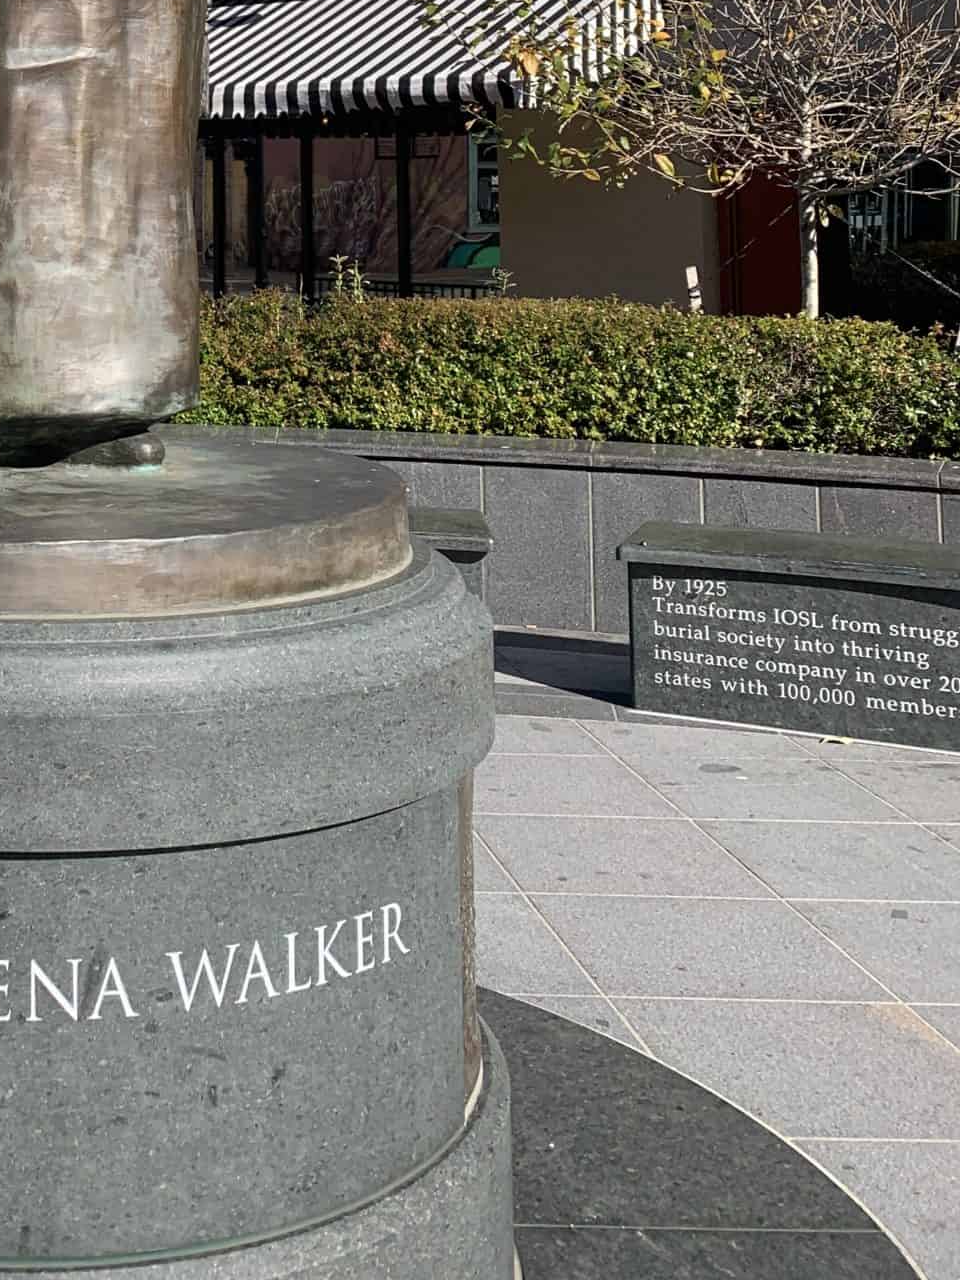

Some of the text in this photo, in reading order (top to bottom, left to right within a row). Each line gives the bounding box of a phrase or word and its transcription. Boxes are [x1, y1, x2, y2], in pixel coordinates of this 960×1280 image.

[652, 575, 728, 597] By 1925
[652, 596, 960, 648] Transforms IOSL from strugg
[653, 620, 930, 670] burial society into thriving
[653, 644, 960, 694] insurance company in over 20
[654, 671, 960, 718] states with 100,000 member
[164, 901, 410, 1012] WALKER
